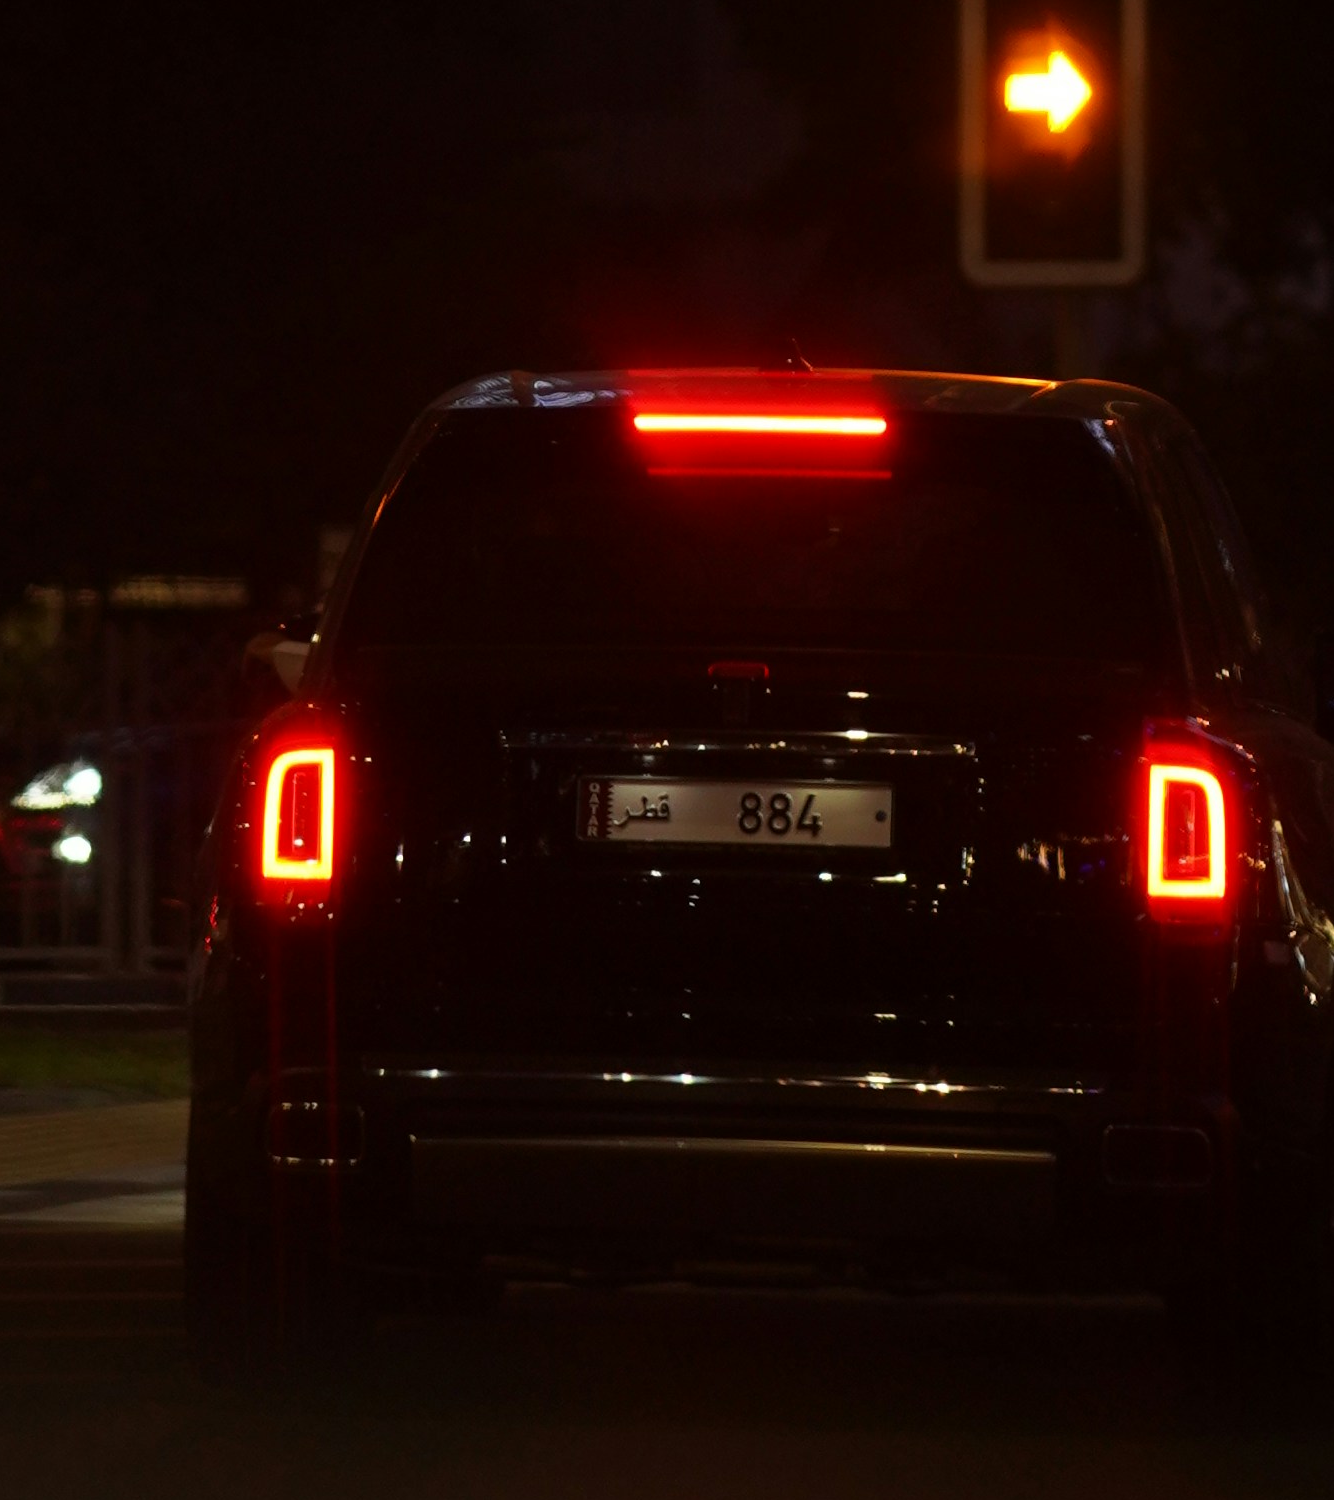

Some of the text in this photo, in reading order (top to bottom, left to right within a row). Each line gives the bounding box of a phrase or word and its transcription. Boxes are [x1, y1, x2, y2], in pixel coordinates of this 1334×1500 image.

[587, 782, 600, 837] QATAR
[612, 791, 671, 827] قطر
[738, 791, 823, 838] 884
